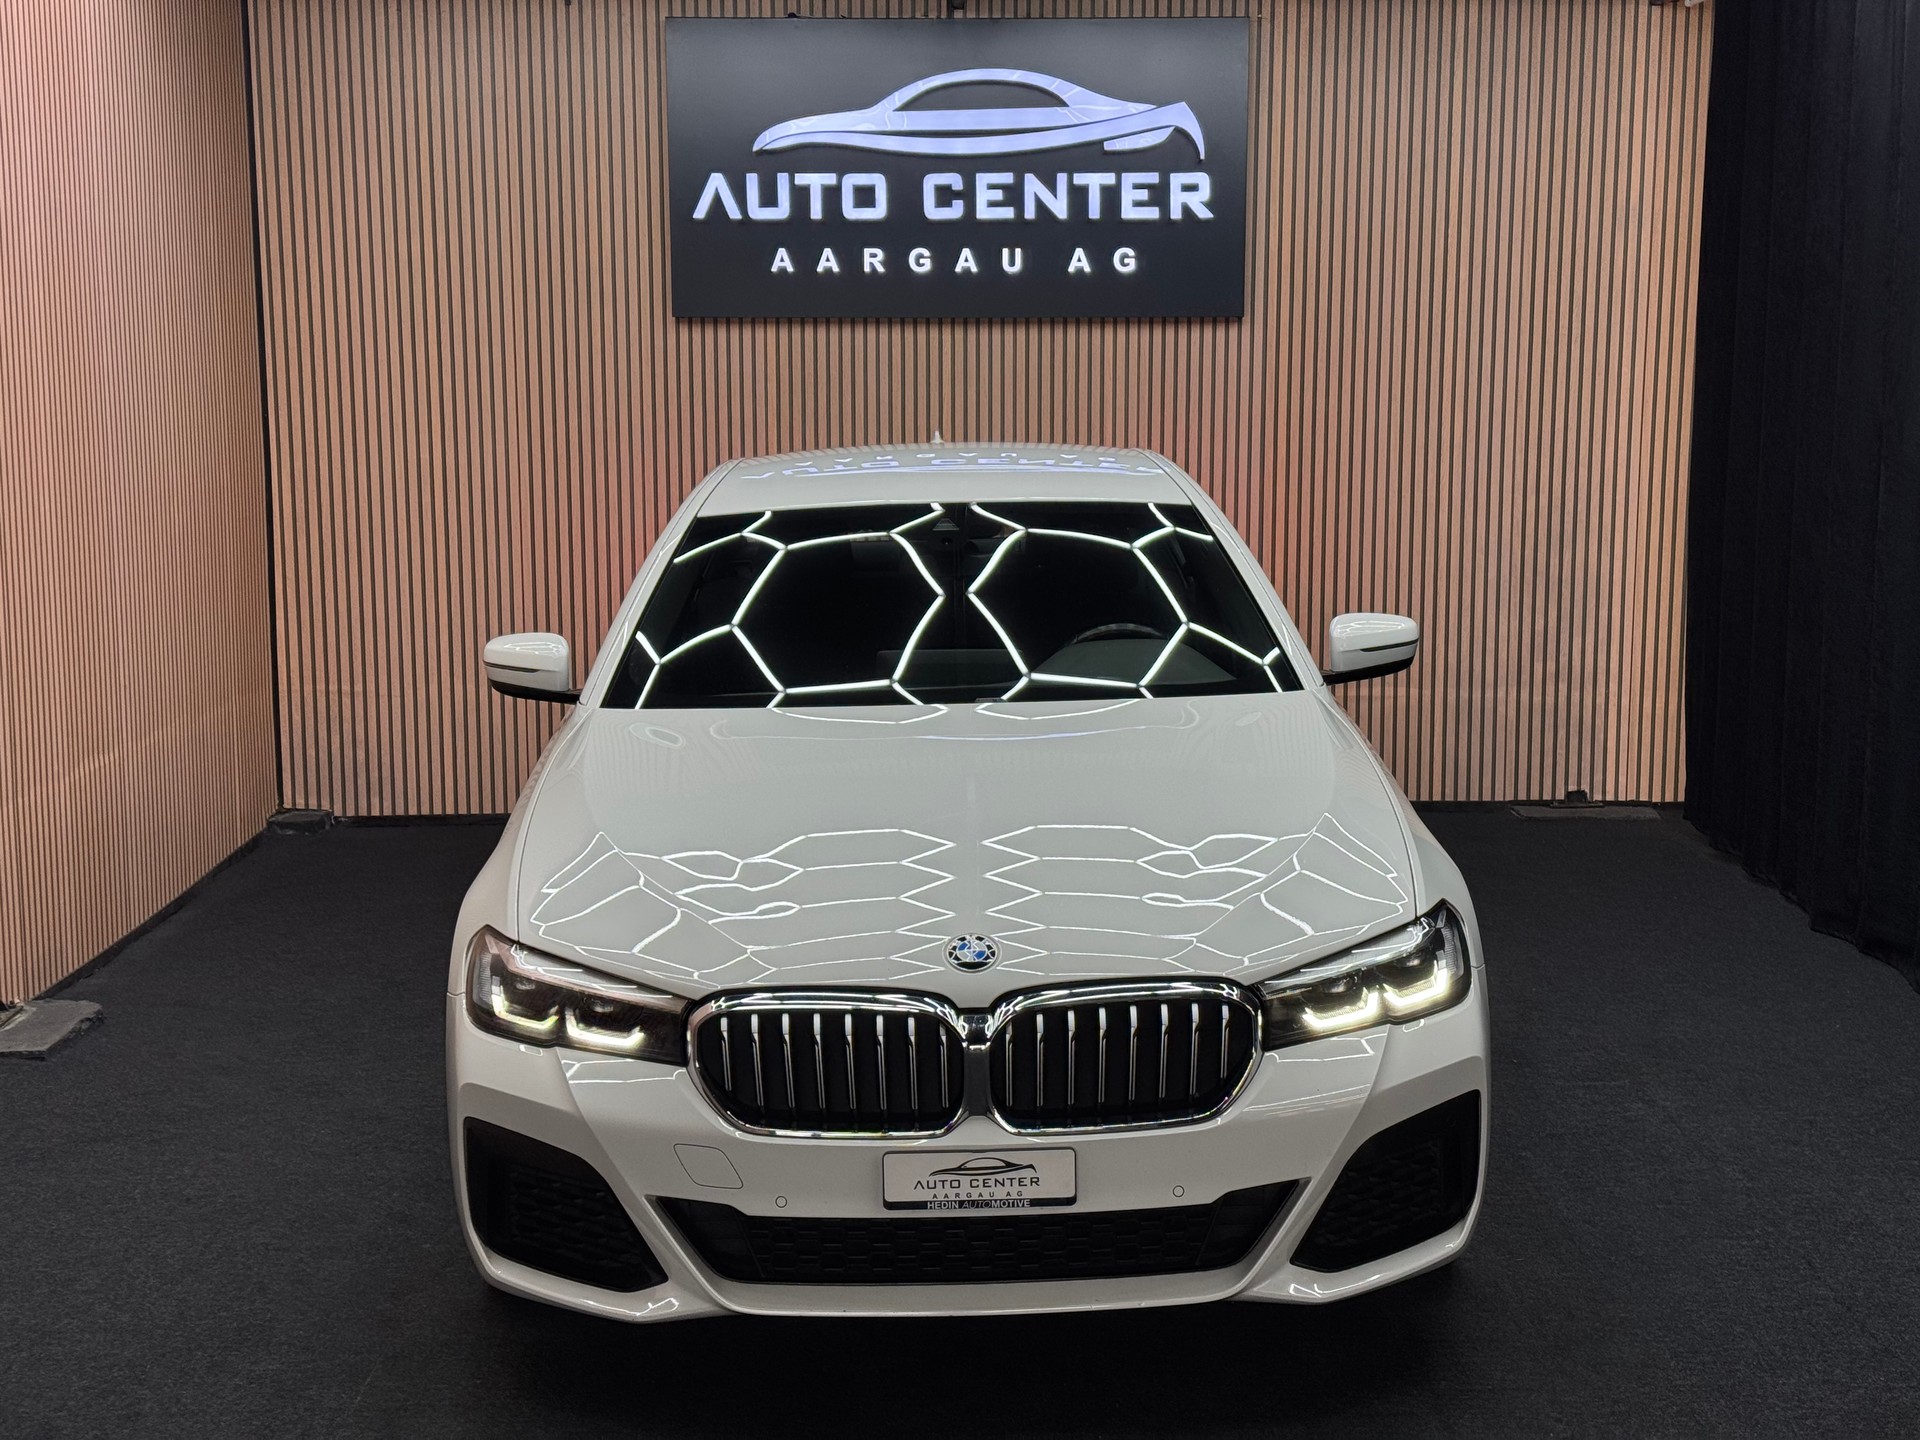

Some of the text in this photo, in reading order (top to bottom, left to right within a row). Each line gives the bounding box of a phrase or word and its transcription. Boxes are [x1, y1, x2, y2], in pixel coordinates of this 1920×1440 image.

[692, 172, 1215, 220] AUTO CENTER
[770, 247, 1137, 274] AARGAU AG
[913, 1176, 1040, 1190] AUTO CENTER
[932, 1191, 995, 1199] AARGAU
[927, 1199, 1031, 1210] HEDIN AUTOMOTIVE
